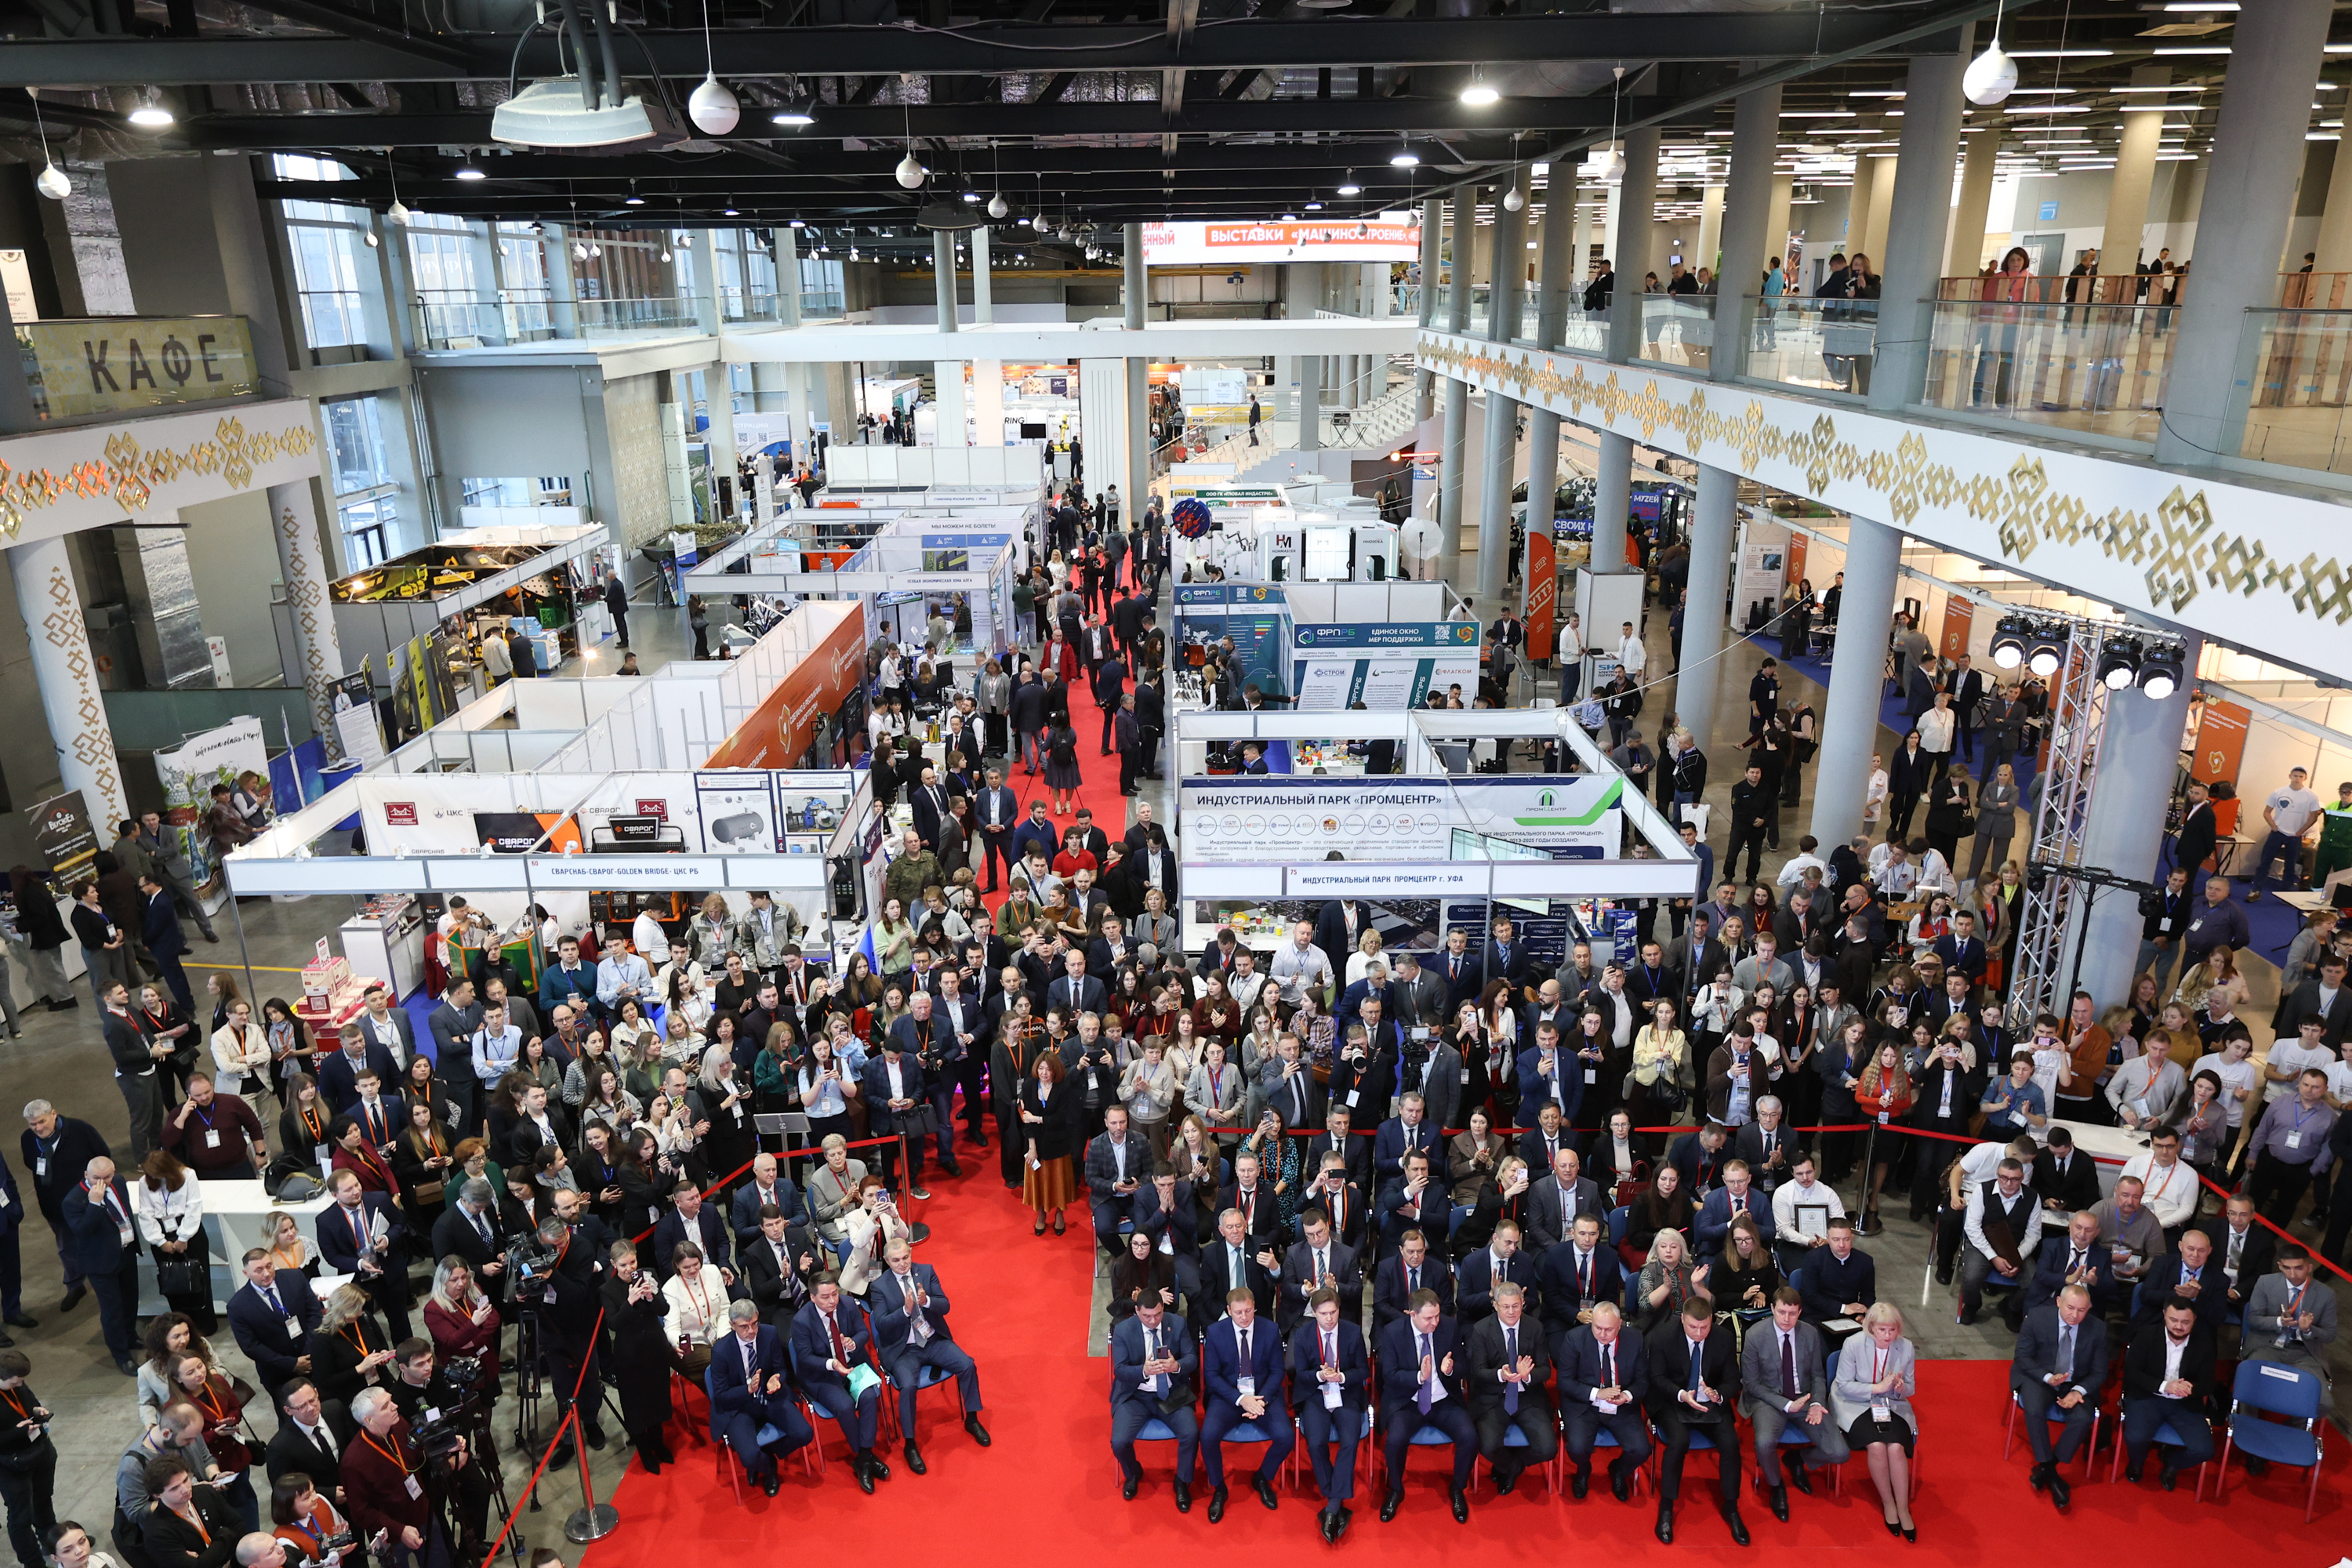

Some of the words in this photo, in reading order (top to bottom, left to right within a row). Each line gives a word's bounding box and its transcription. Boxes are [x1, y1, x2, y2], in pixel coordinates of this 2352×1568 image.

[1210, 228, 1284, 242] ВЫСТАВКИ
[84, 334, 224, 394] КАФЕ
[1554, 520, 1585, 531] СВОИХ
[1530, 580, 1553, 608] УТТЗ
[1317, 628, 1356, 637] ФРПРБ
[1383, 635, 1424, 644] ПОДДЕРЖКИ
[1414, 676, 1426, 705] ФРПРБ
[1197, 793, 1315, 807] ИНДУСТРИАЛЬНЫЙ
[1319, 794, 1350, 805] ПАРК
[1354, 794, 1442, 807] «ПРОМЦЕНТР»
[1302, 876, 1370, 884] ИНДУСТРИАЛЬНЫЙ
[1394, 875, 1436, 884] ПРОМЦЕНТР
